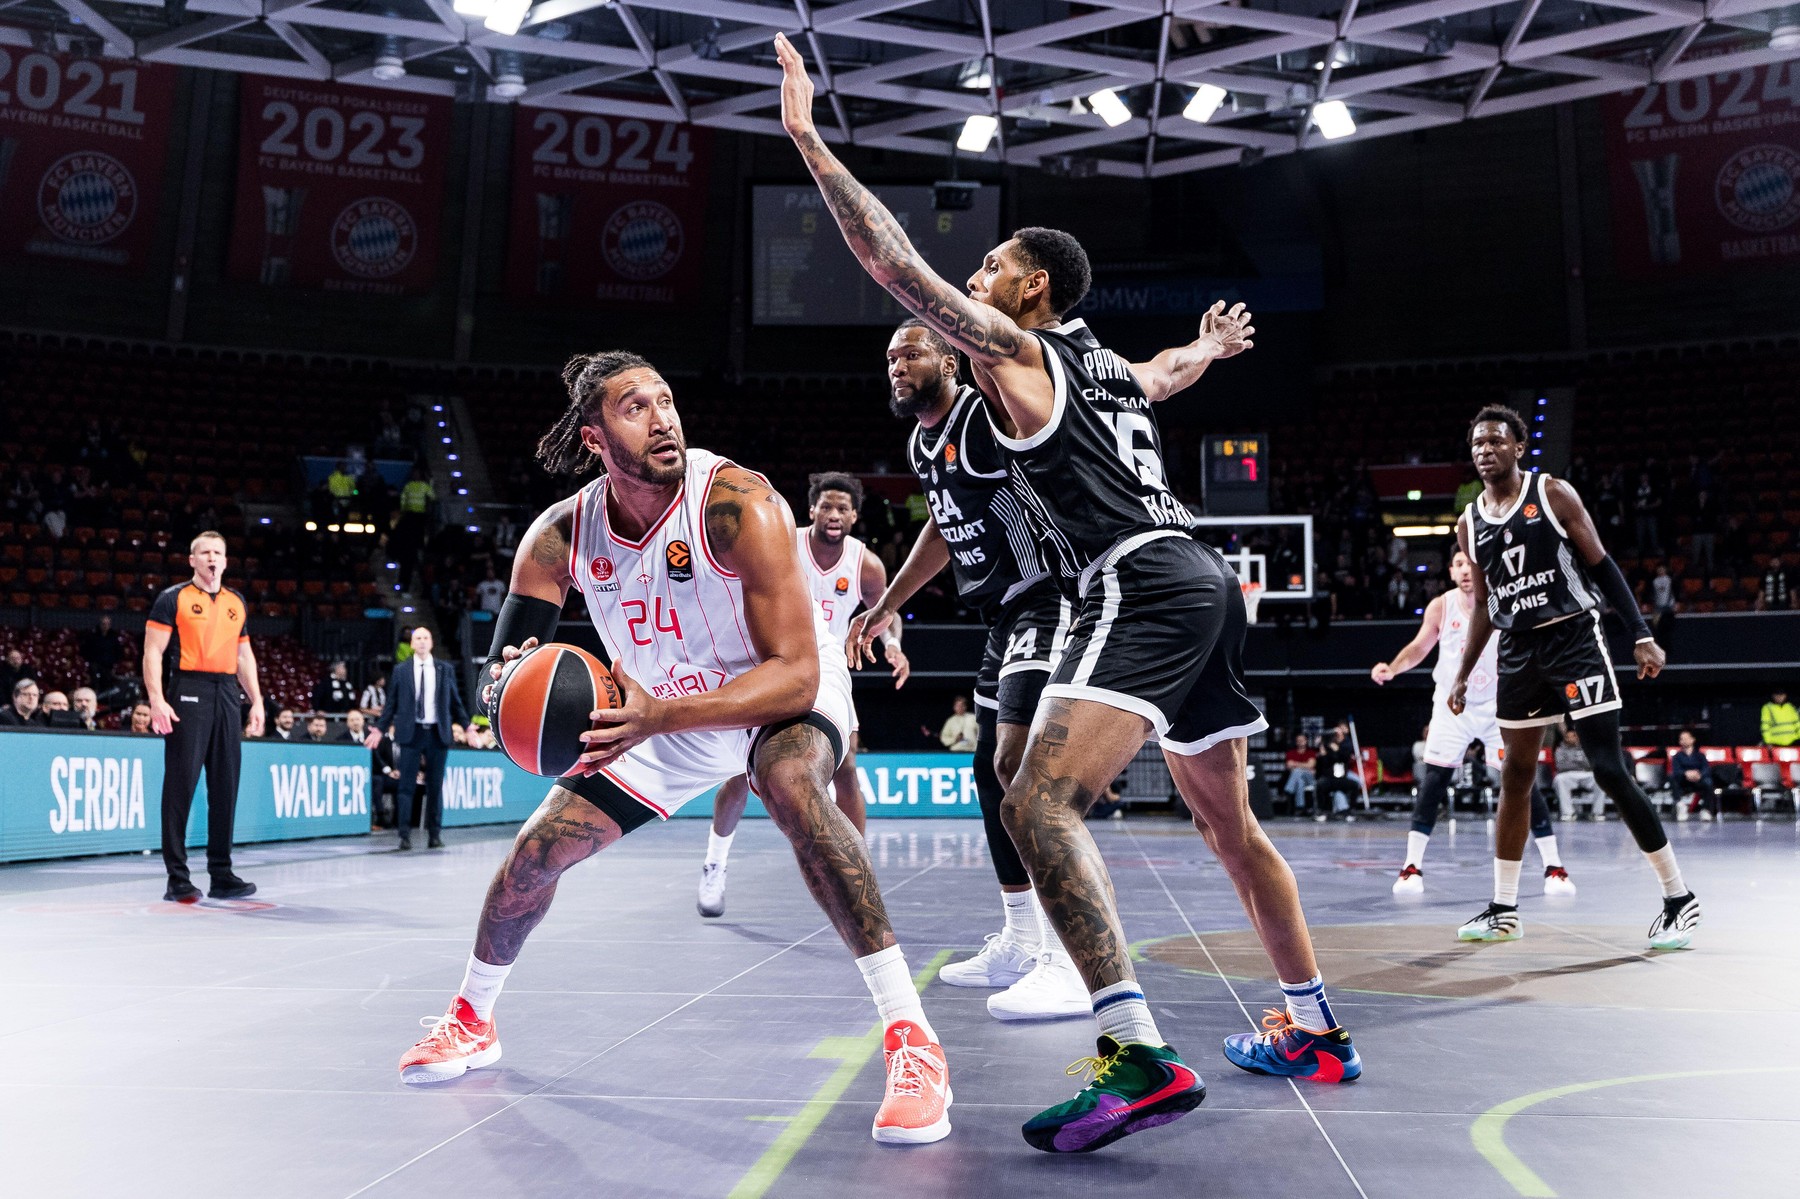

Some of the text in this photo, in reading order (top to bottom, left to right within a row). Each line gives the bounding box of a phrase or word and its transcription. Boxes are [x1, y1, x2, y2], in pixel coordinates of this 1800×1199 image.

[1620, 60, 1800, 129] 2024
[0, 108, 144, 140] AYERN BASKETBALL
[260, 101, 425, 169] 2023
[532, 111, 695, 173] 2024
[71, 156, 132, 197] BAYERN
[259, 156, 423, 185] FC BAYERN BASKETBALL
[533, 165, 690, 188] FC BAYERN BASKETBALL
[1241, 457, 1257, 481] 7
[929, 488, 964, 525] 24
[1501, 544, 1526, 577] 17
[621, 597, 684, 646] 24
[1576, 675, 1605, 706] 17
[50, 756, 145, 834] SERBIA
[270, 763, 368, 819] WALTER
[856, 767, 980, 805] ALTER
